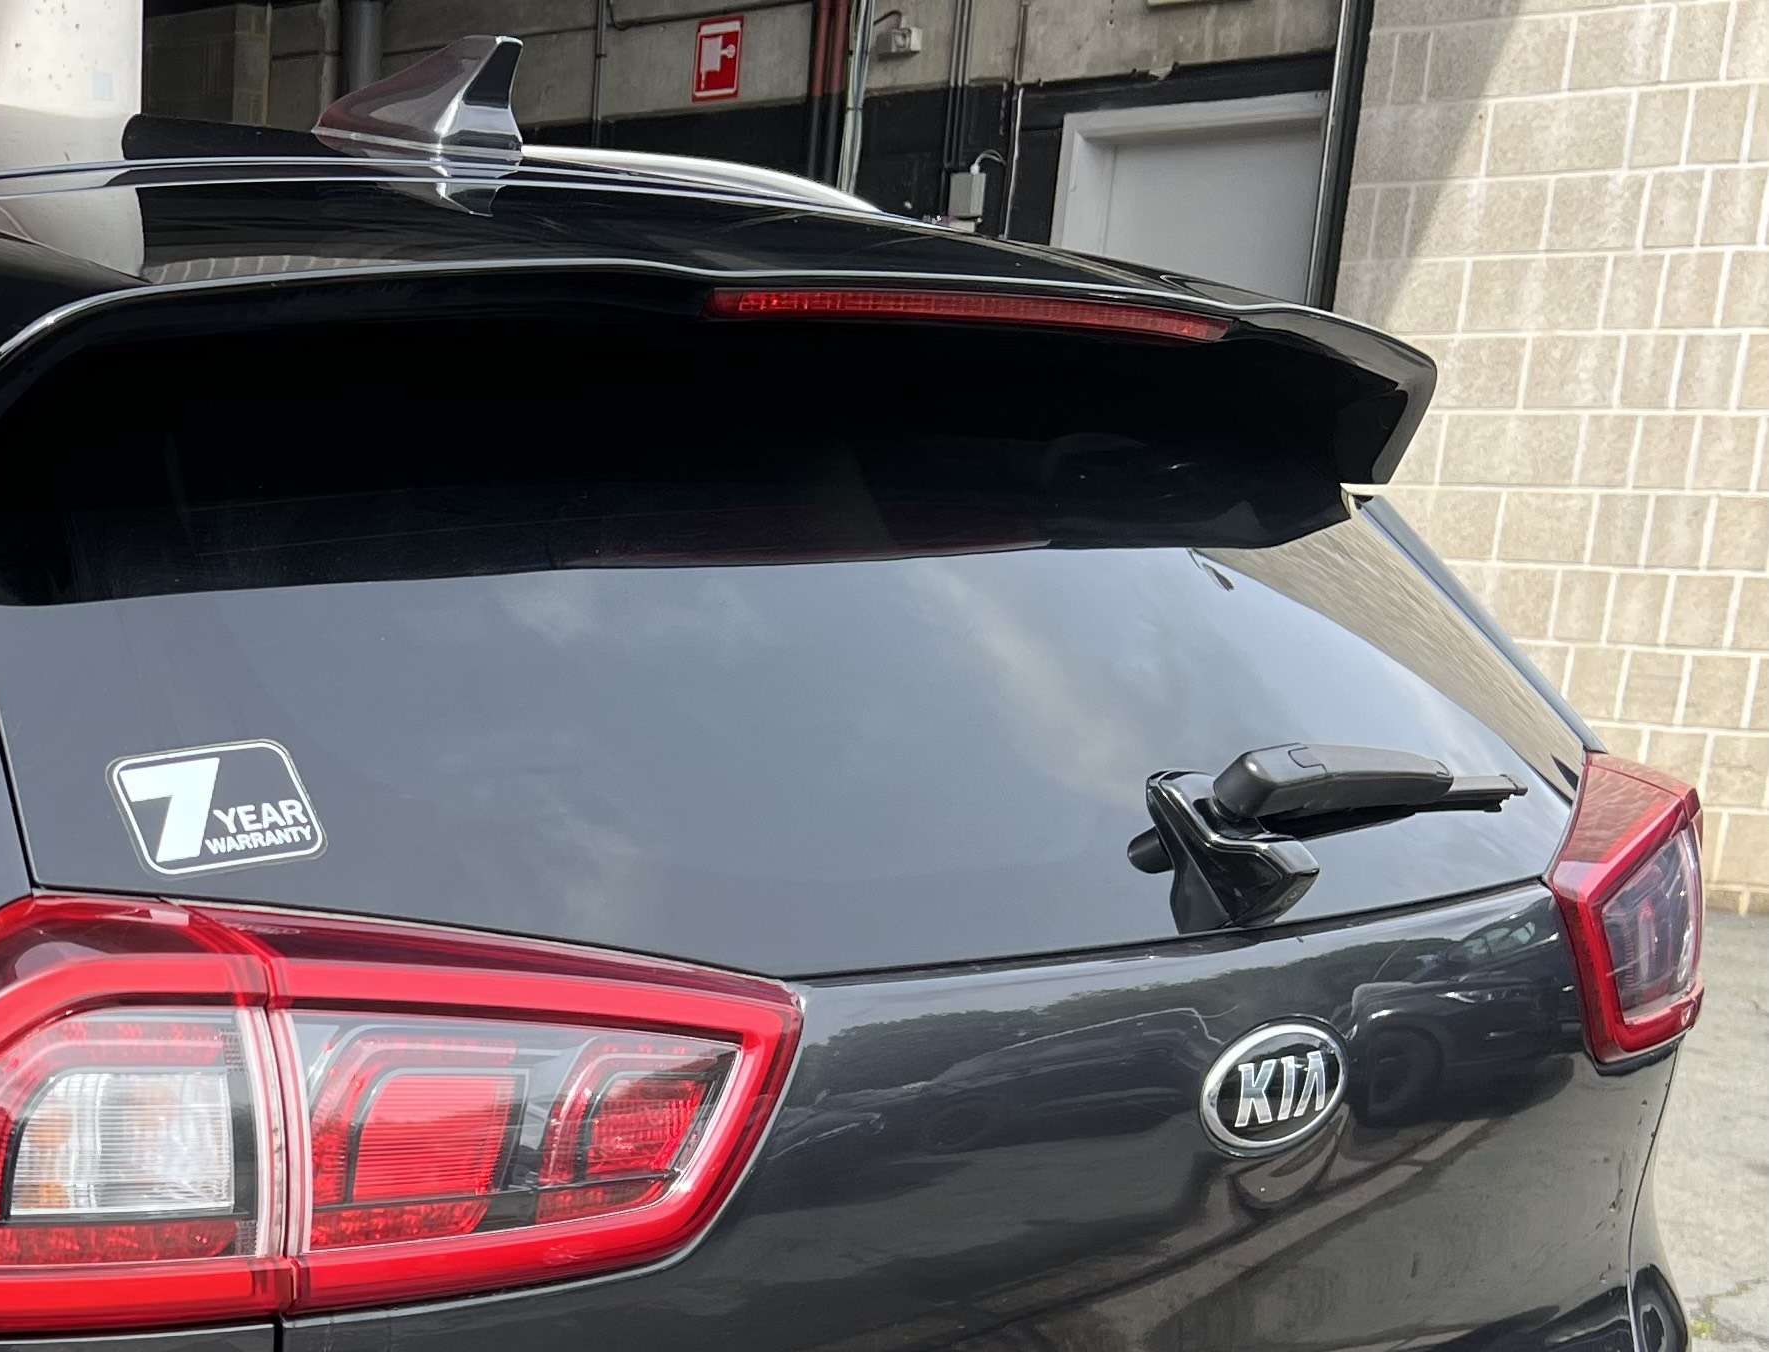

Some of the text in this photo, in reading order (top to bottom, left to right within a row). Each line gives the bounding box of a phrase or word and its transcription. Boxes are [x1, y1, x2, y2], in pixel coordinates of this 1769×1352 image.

[119, 757, 308, 863] 7 YEAR
[204, 824, 312, 855] WARRANTY
[1234, 1050, 1326, 1128] KIA
